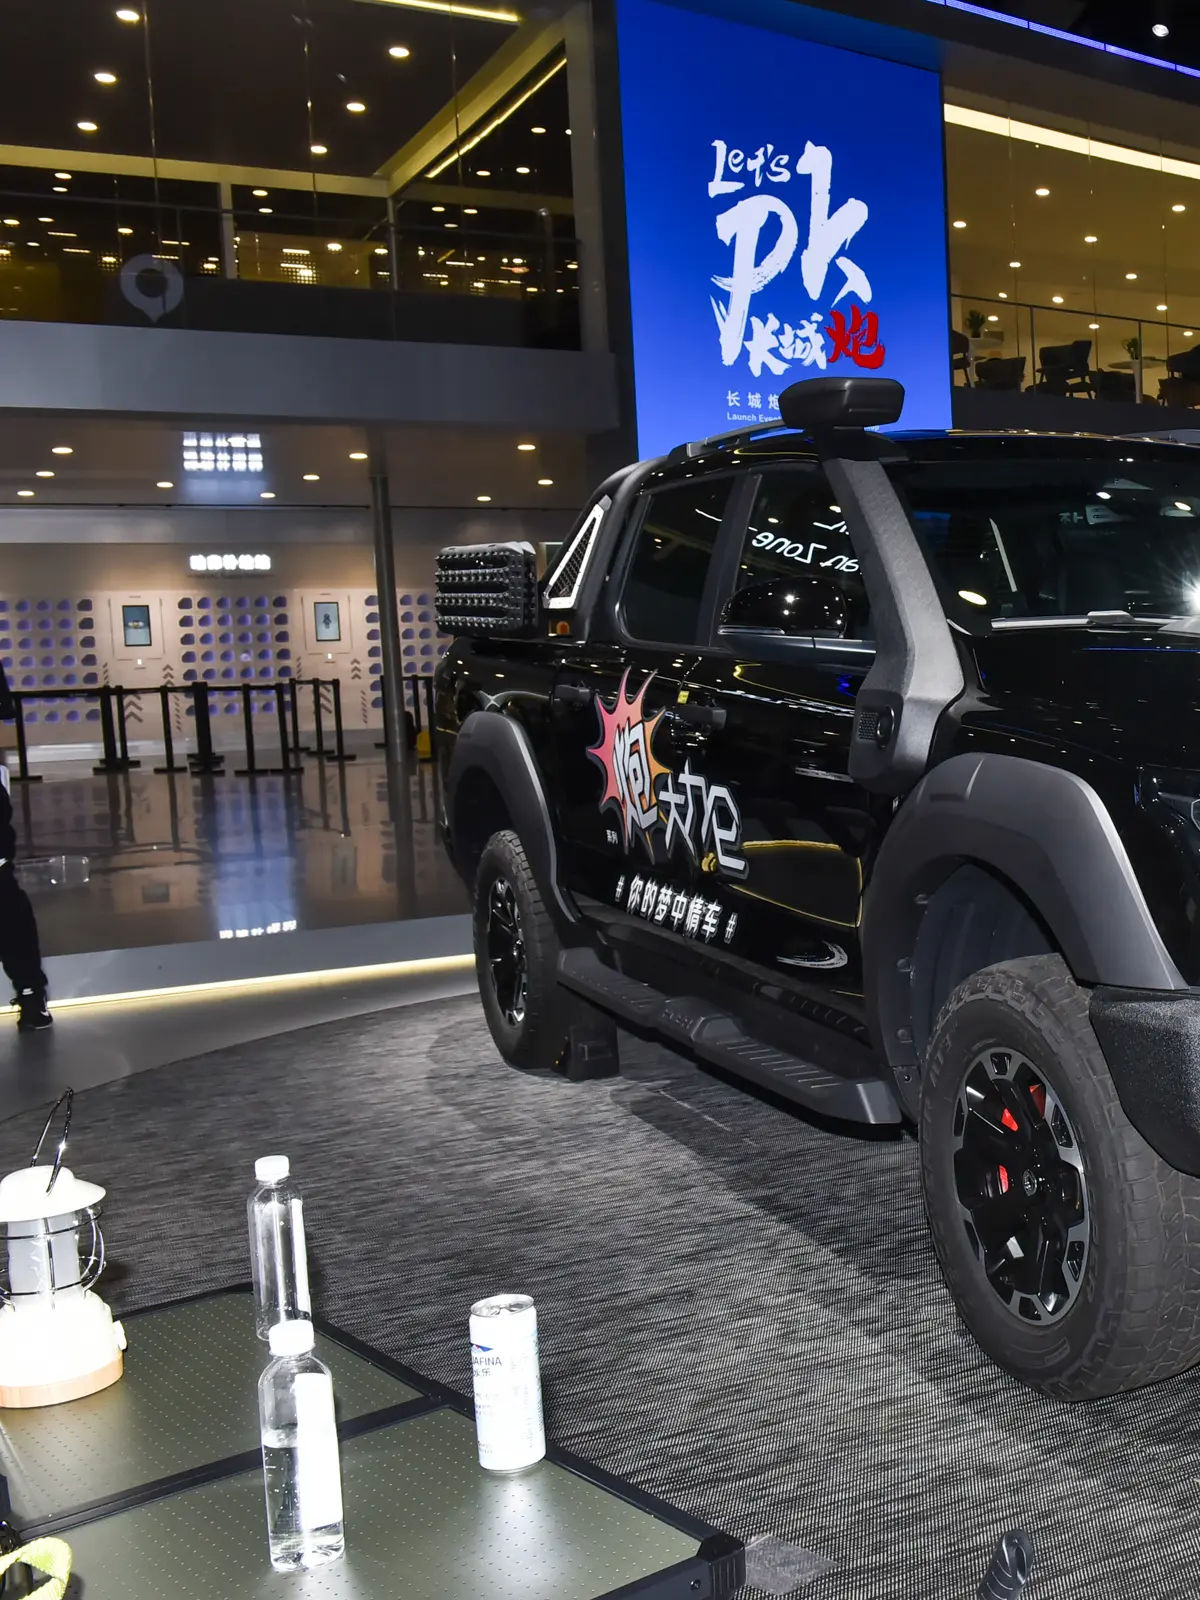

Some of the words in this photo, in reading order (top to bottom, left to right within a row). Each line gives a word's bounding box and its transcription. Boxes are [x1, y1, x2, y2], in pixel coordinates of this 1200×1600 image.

[708, 139, 791, 198] Let's
[744, 305, 886, 377] 长城炮
[727, 412, 756, 422] Launch
